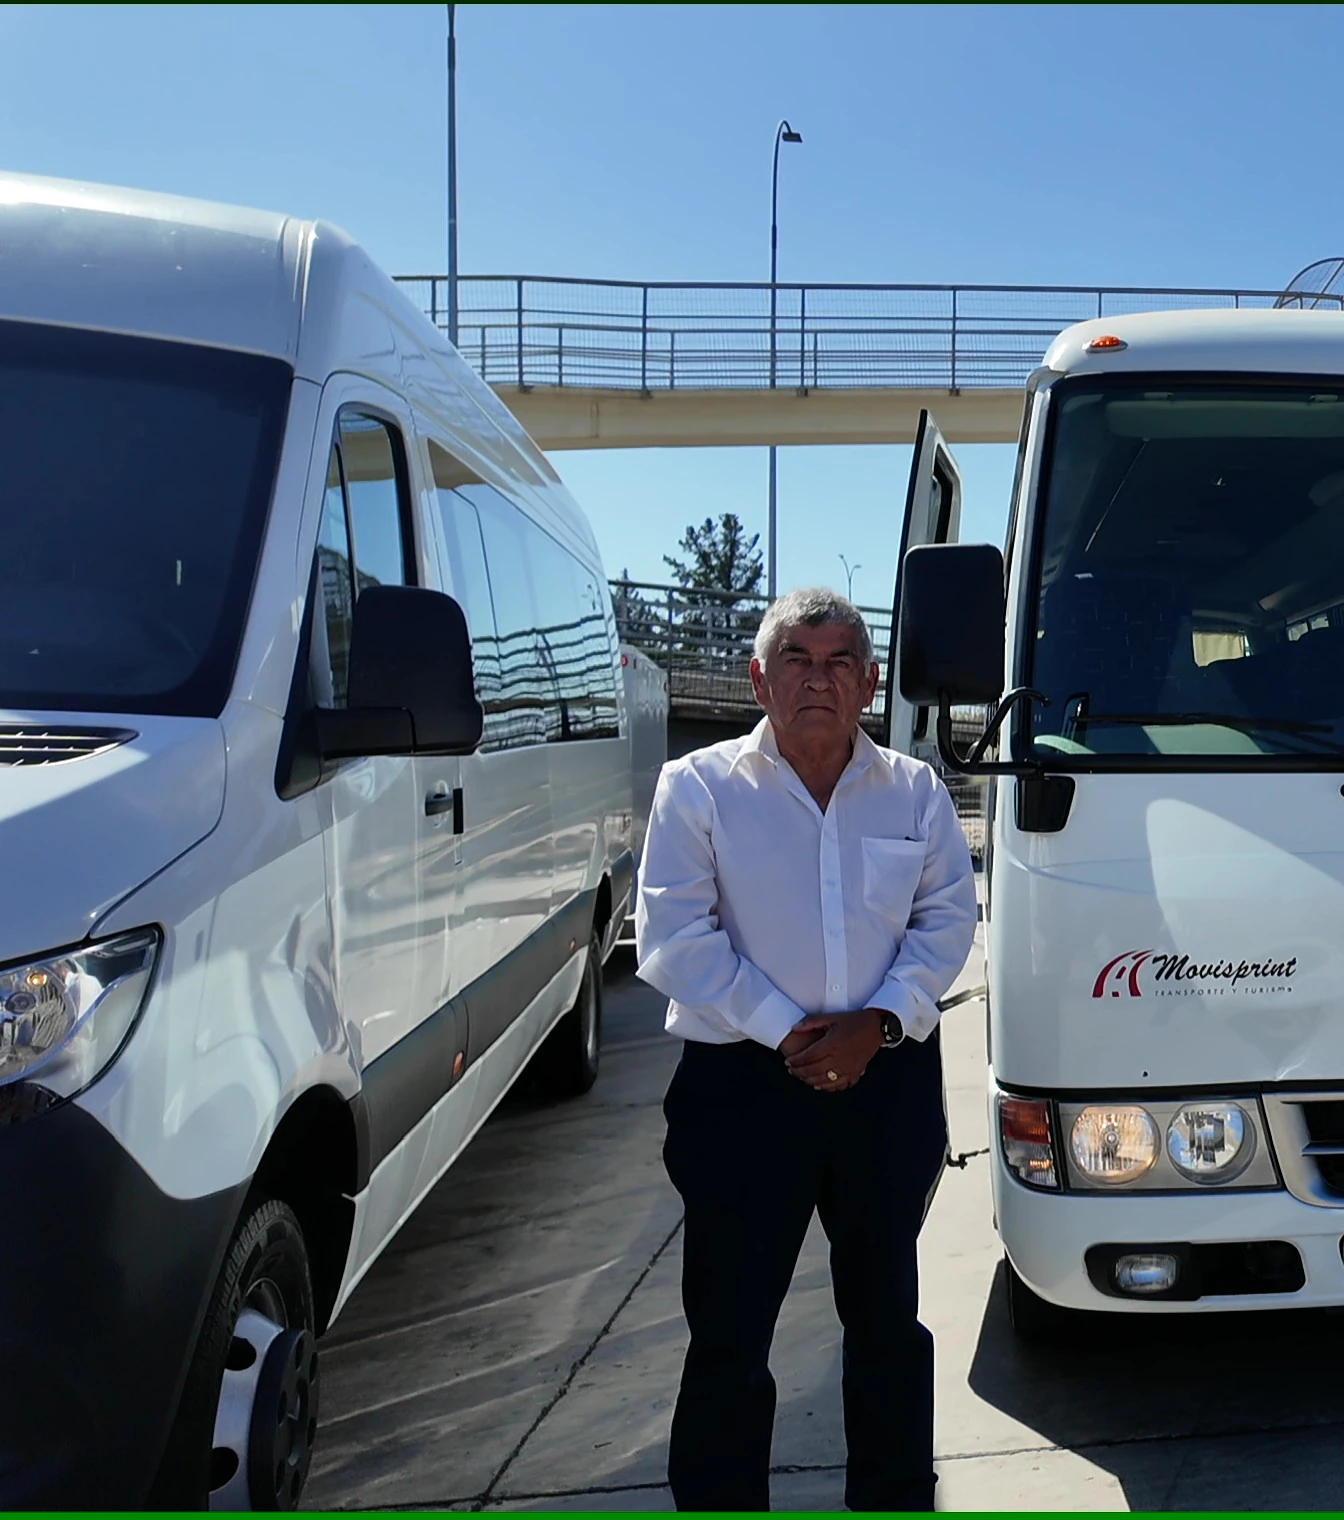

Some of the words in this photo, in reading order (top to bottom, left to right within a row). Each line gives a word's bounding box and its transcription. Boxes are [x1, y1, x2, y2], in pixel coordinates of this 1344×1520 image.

[1152, 953, 1297, 986] Movisprint
[1155, 988, 1225, 997] TRANSPORTE
[1245, 986, 1293, 995] TURISMO
